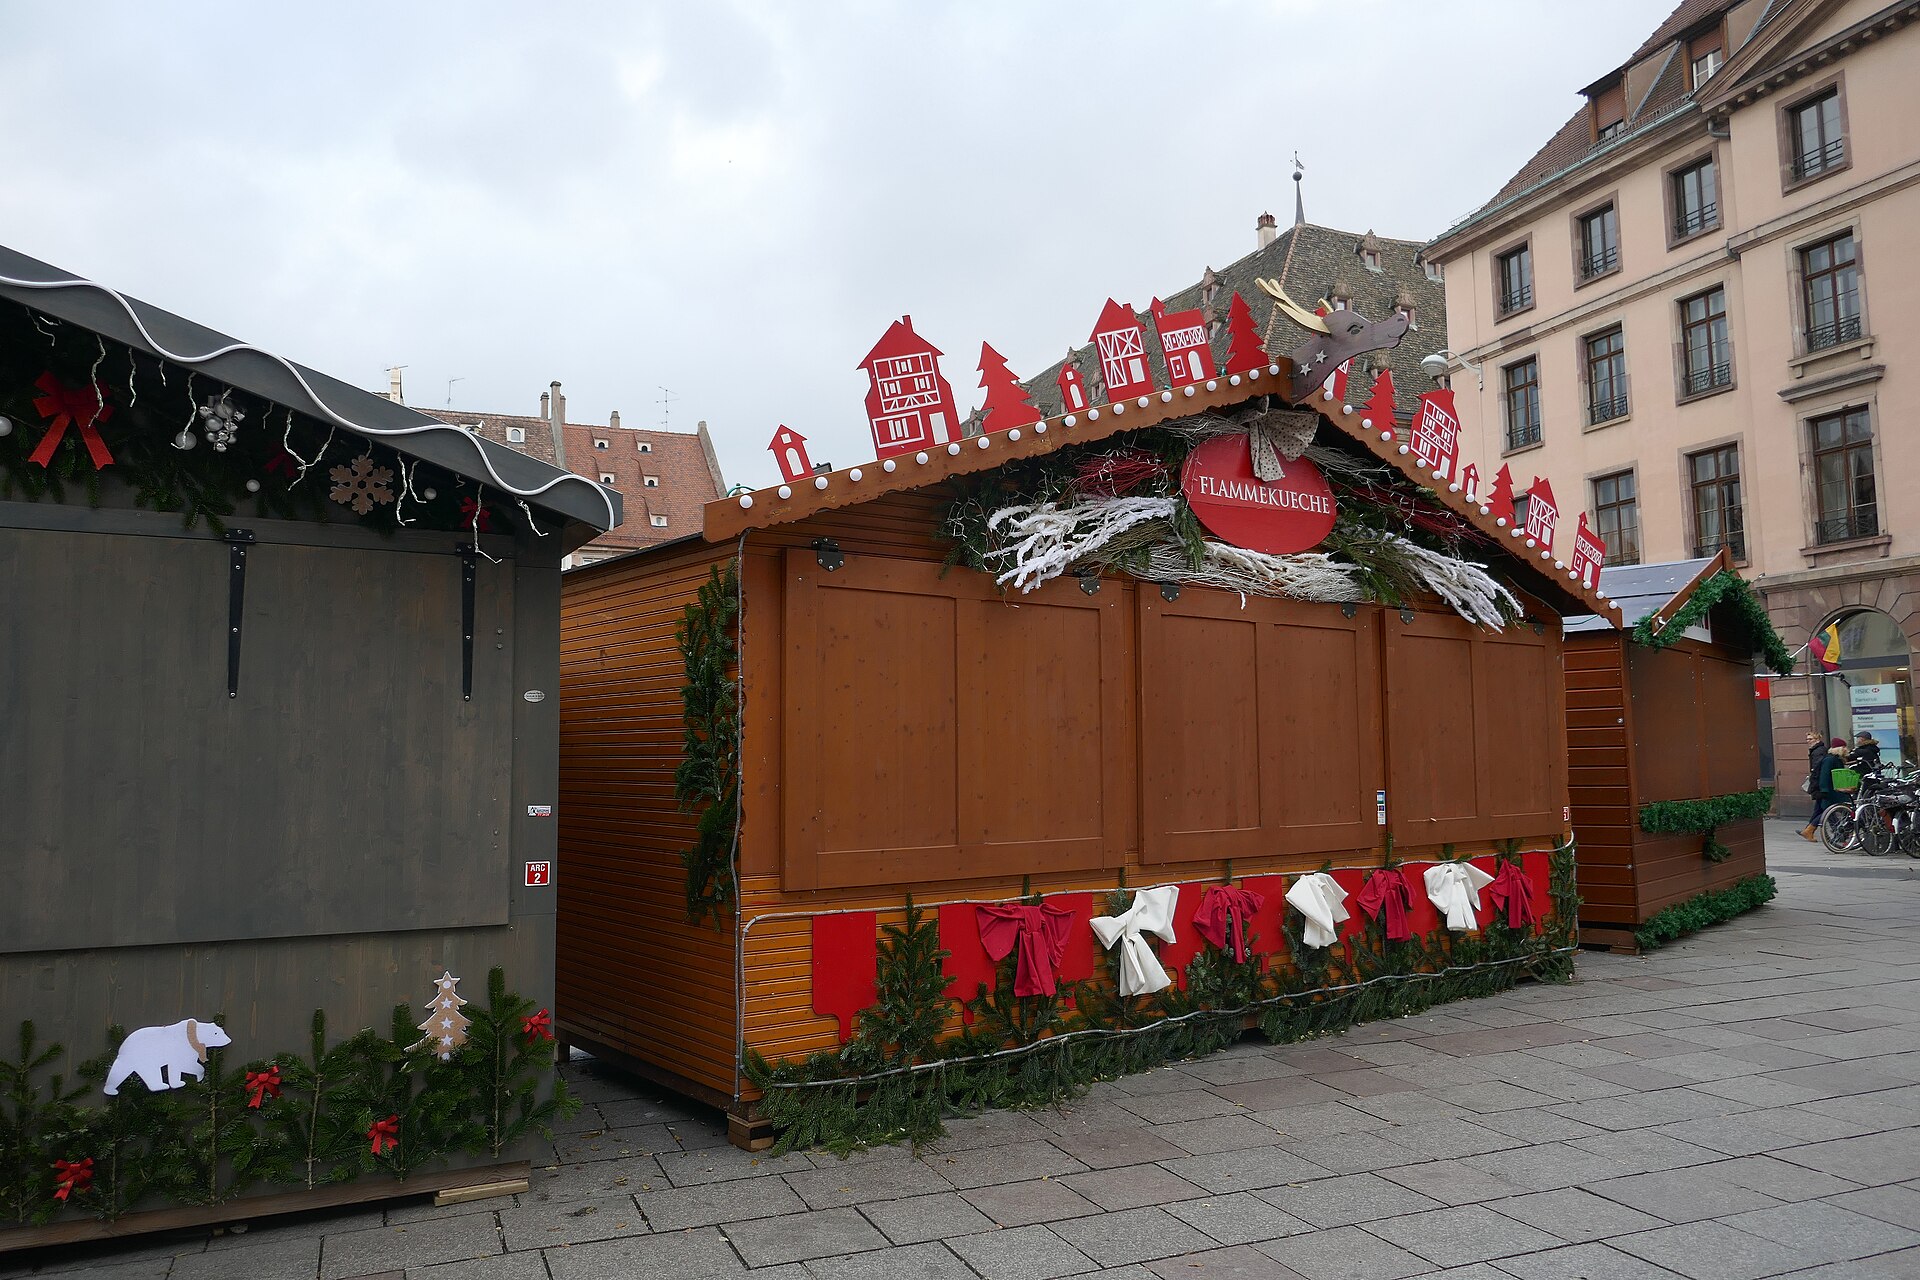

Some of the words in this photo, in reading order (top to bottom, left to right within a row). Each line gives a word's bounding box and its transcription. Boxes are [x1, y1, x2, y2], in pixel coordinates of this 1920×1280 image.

[1199, 475, 1330, 514] FLAMMEKUECHE
[530, 864, 546, 872] ARC
[534, 873, 541, 883] 2
